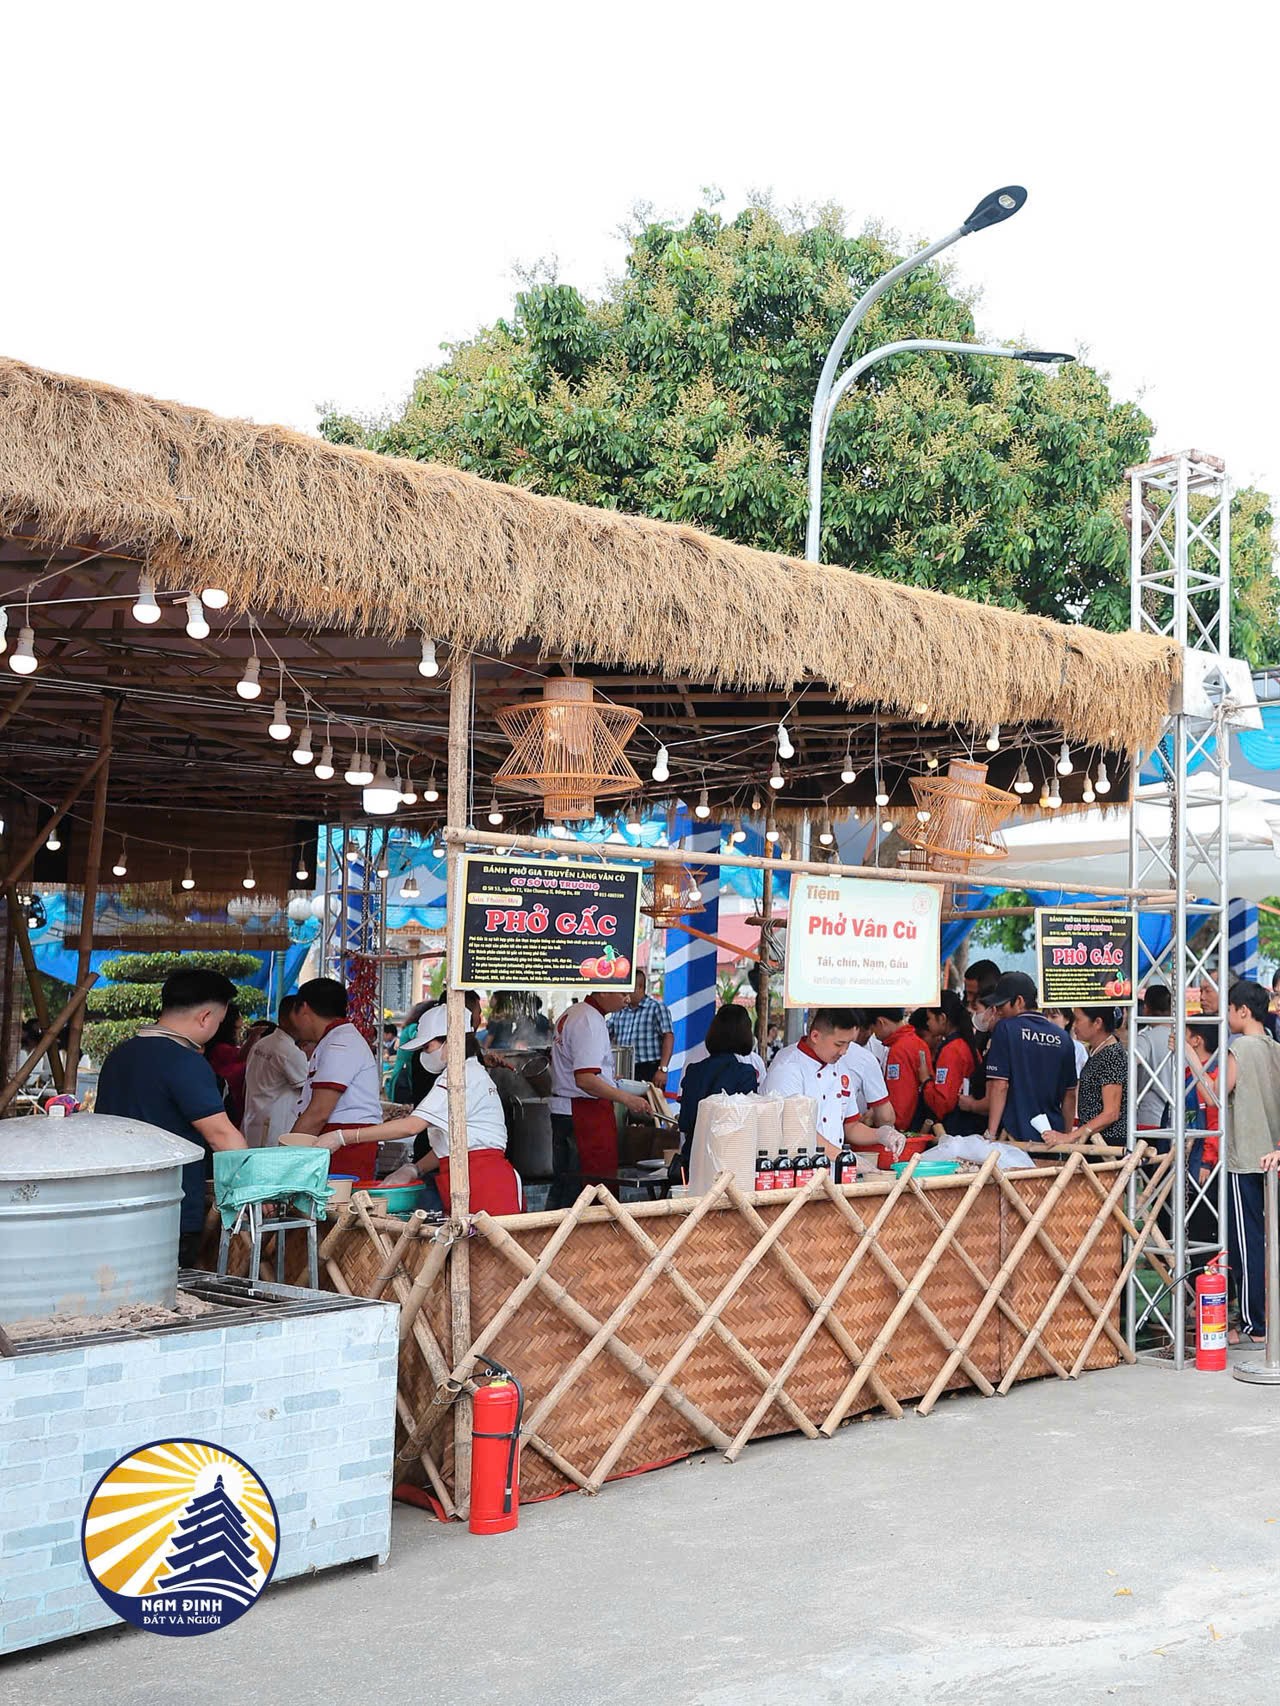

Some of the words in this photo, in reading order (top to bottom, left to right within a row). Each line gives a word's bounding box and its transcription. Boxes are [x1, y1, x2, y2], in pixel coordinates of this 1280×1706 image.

[483, 865, 507, 874] BÁNH
[528, 868, 542, 876] GIA
[577, 870, 597, 880] LÀNG
[806, 884, 840, 903] Tiệm
[484, 903, 550, 934] PHỞ
[555, 905, 617, 936] GẤC
[808, 912, 847, 936] Phở
[852, 918, 888, 938] Vân
[893, 920, 917, 940] Cù
[1052, 942, 1087, 965] PHỞ
[1090, 942, 1123, 966] GẤC
[1021, 1030, 1062, 1045] NATOS
